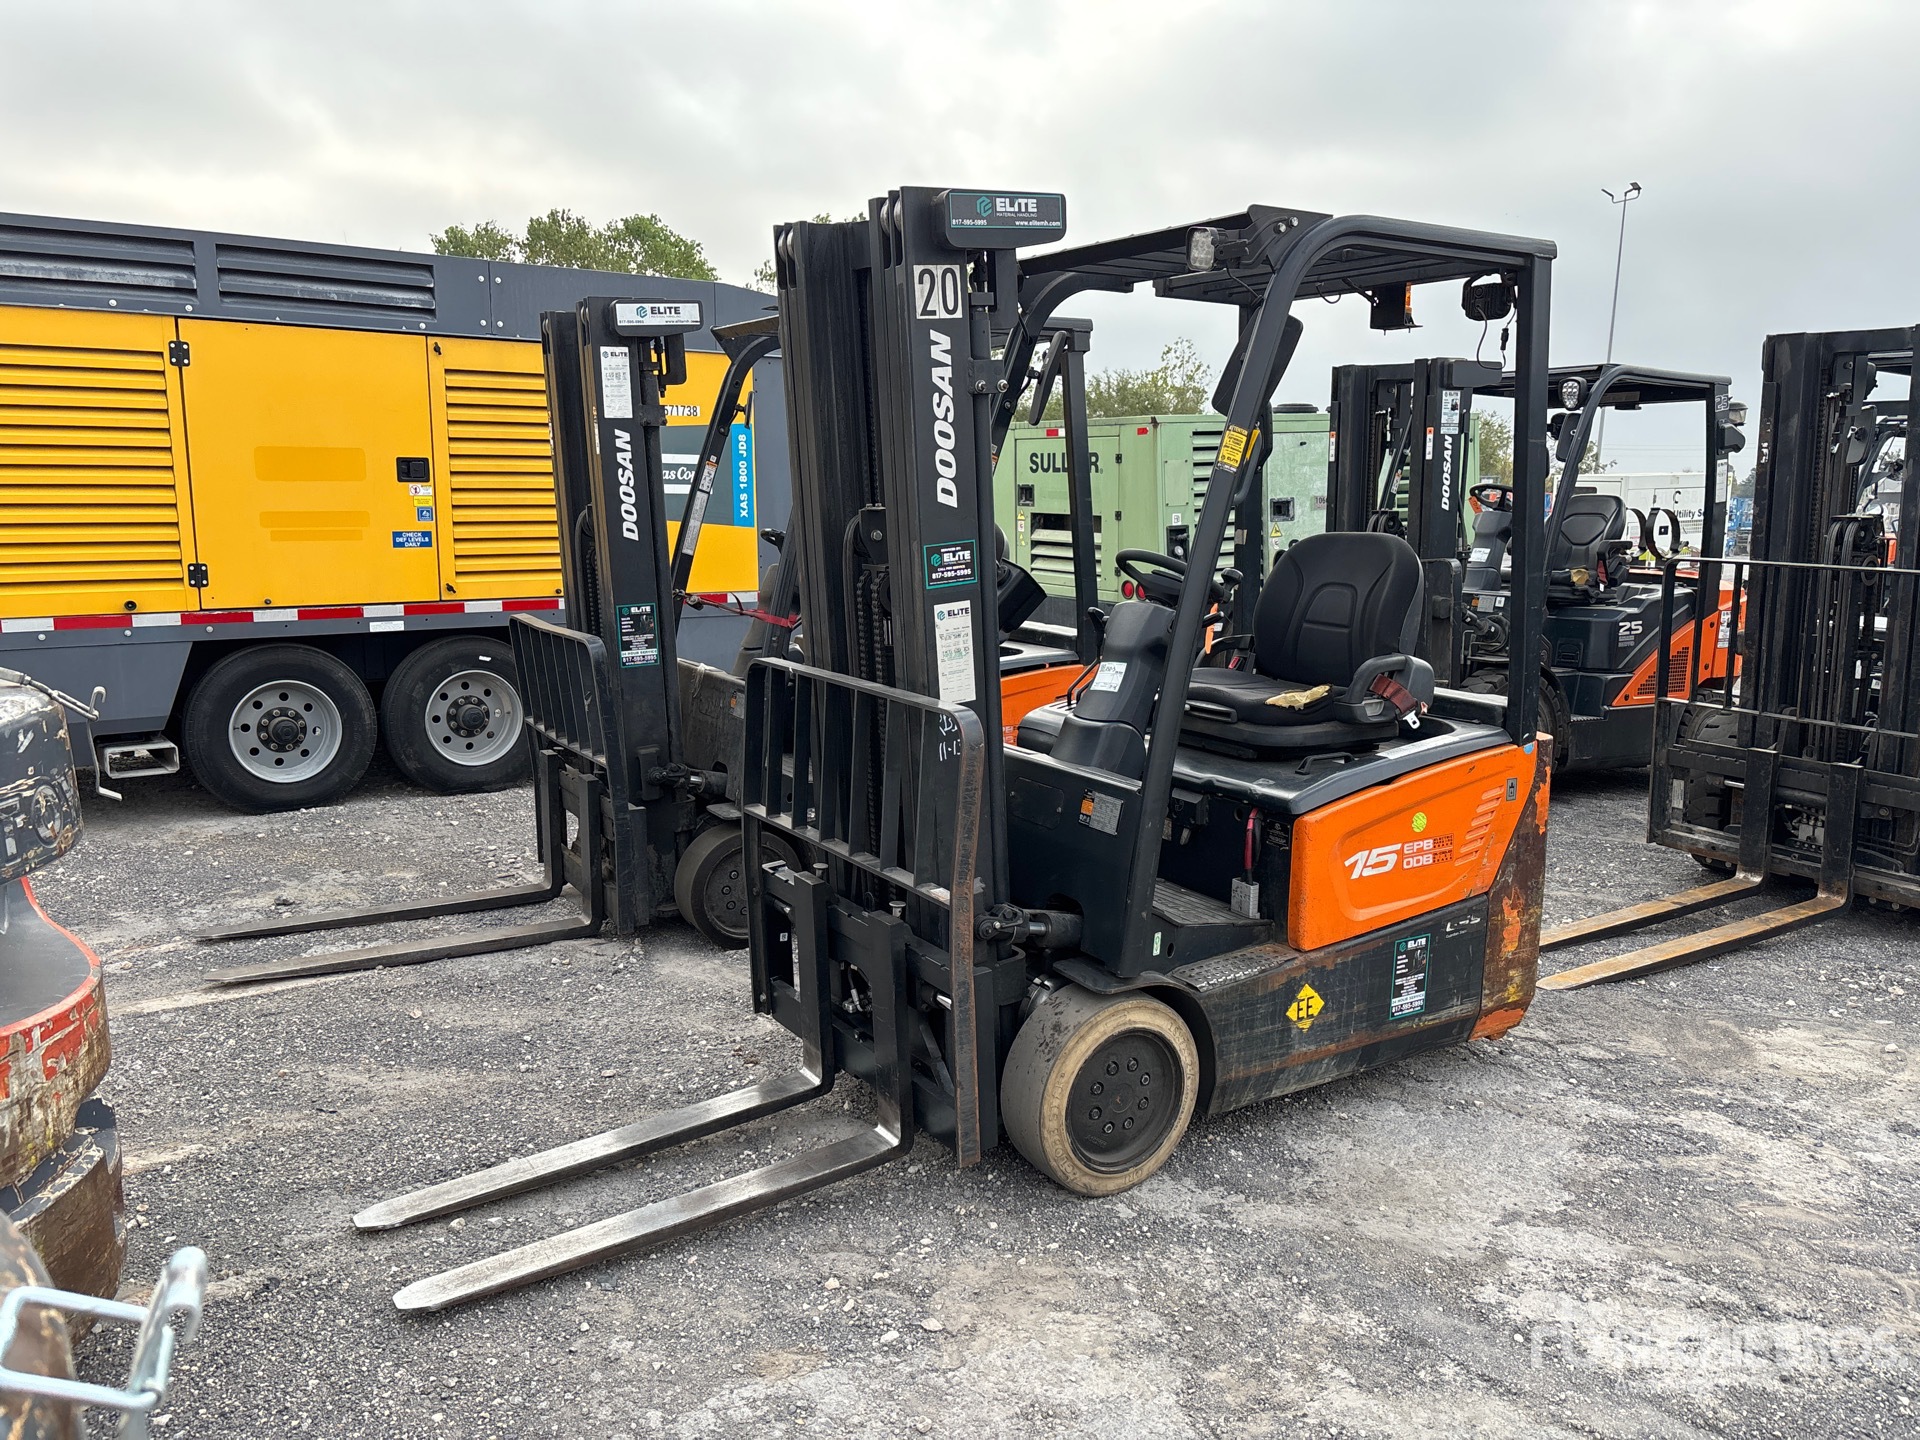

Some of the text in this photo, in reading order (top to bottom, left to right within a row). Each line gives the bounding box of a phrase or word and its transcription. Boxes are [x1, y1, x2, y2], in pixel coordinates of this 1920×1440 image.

[996, 197, 1037, 212] ELITE
[918, 268, 959, 317] 20
[650, 306, 681, 315] ELITE
[929, 328, 958, 509] DOOSAN
[738, 433, 749, 518] XAS 1800 JD8
[1441, 434, 1453, 511] DOOSAN
[614, 428, 639, 541] DOOSAN
[944, 550, 971, 562] ELITE
[932, 569, 971, 579] 817-595-5995
[947, 607, 970, 617] ELITE
[1618, 621, 1643, 635] 25
[1344, 839, 1433, 880] 15 EPB
[1403, 853, 1433, 869] ODB
[1407, 937, 1427, 949] ELITE
[1297, 996, 1315, 1020] EE
